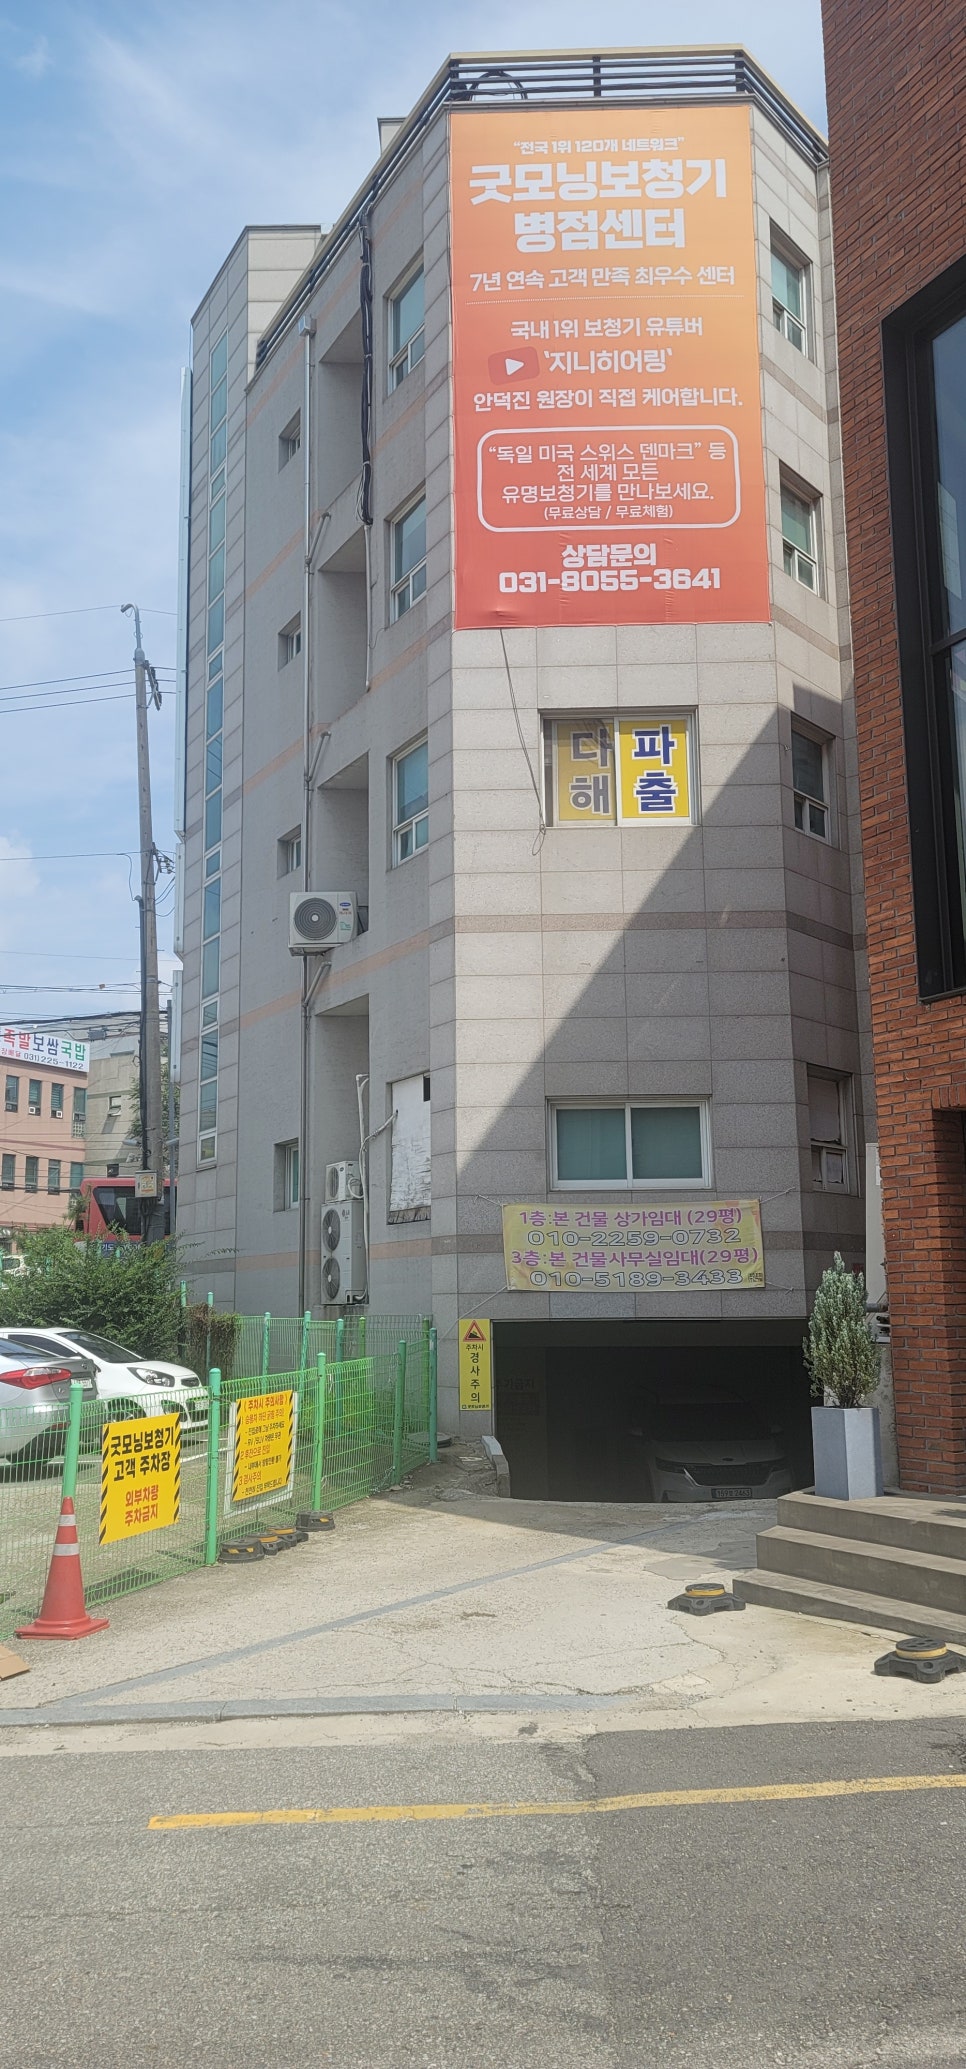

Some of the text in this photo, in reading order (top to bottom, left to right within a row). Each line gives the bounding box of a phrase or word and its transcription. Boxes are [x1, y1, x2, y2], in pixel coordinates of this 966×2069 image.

[514, 140, 548, 154] “전국
[551, 140, 571, 153] 1위
[575, 139, 618, 153] 120개
[469, 159, 727, 205] 굿모닝보청기
[514, 208, 685, 253] 병점센터
[469, 266, 735, 292] 7년 연속 고객 만족 최우수 센터
[511, 317, 703, 339] 국내 1위 보청기 유튜버
[473, 387, 743, 412] 안덕진 원장이 직접 케어합니다.
[488, 442, 727, 463] “독일 미국 스위스 덴마크” 등
[557, 463, 659, 482] 전 세계 모든
[501, 482, 714, 504] 유명보청기를 만나보세요.
[544, 506, 602, 521] (무료상담
[615, 504, 673, 519] 무료체험)
[561, 543, 657, 568] 상담문의
[499, 568, 721, 593] 031-8055-3641
[575, 1211, 609, 1227] 건물
[614, 1210, 681, 1227] 상가임대
[687, 1208, 742, 1225] (29평)
[527, 1228, 742, 1246] 010-2259-0732
[529, 1269, 743, 1287] 010-5189-3433
[110, 1426, 174, 1458] 굿모닝보청기
[114, 1451, 170, 1482] 고객 주차장
[125, 1484, 159, 1507] 외부차량
[125, 1503, 158, 1527] 주차금지
